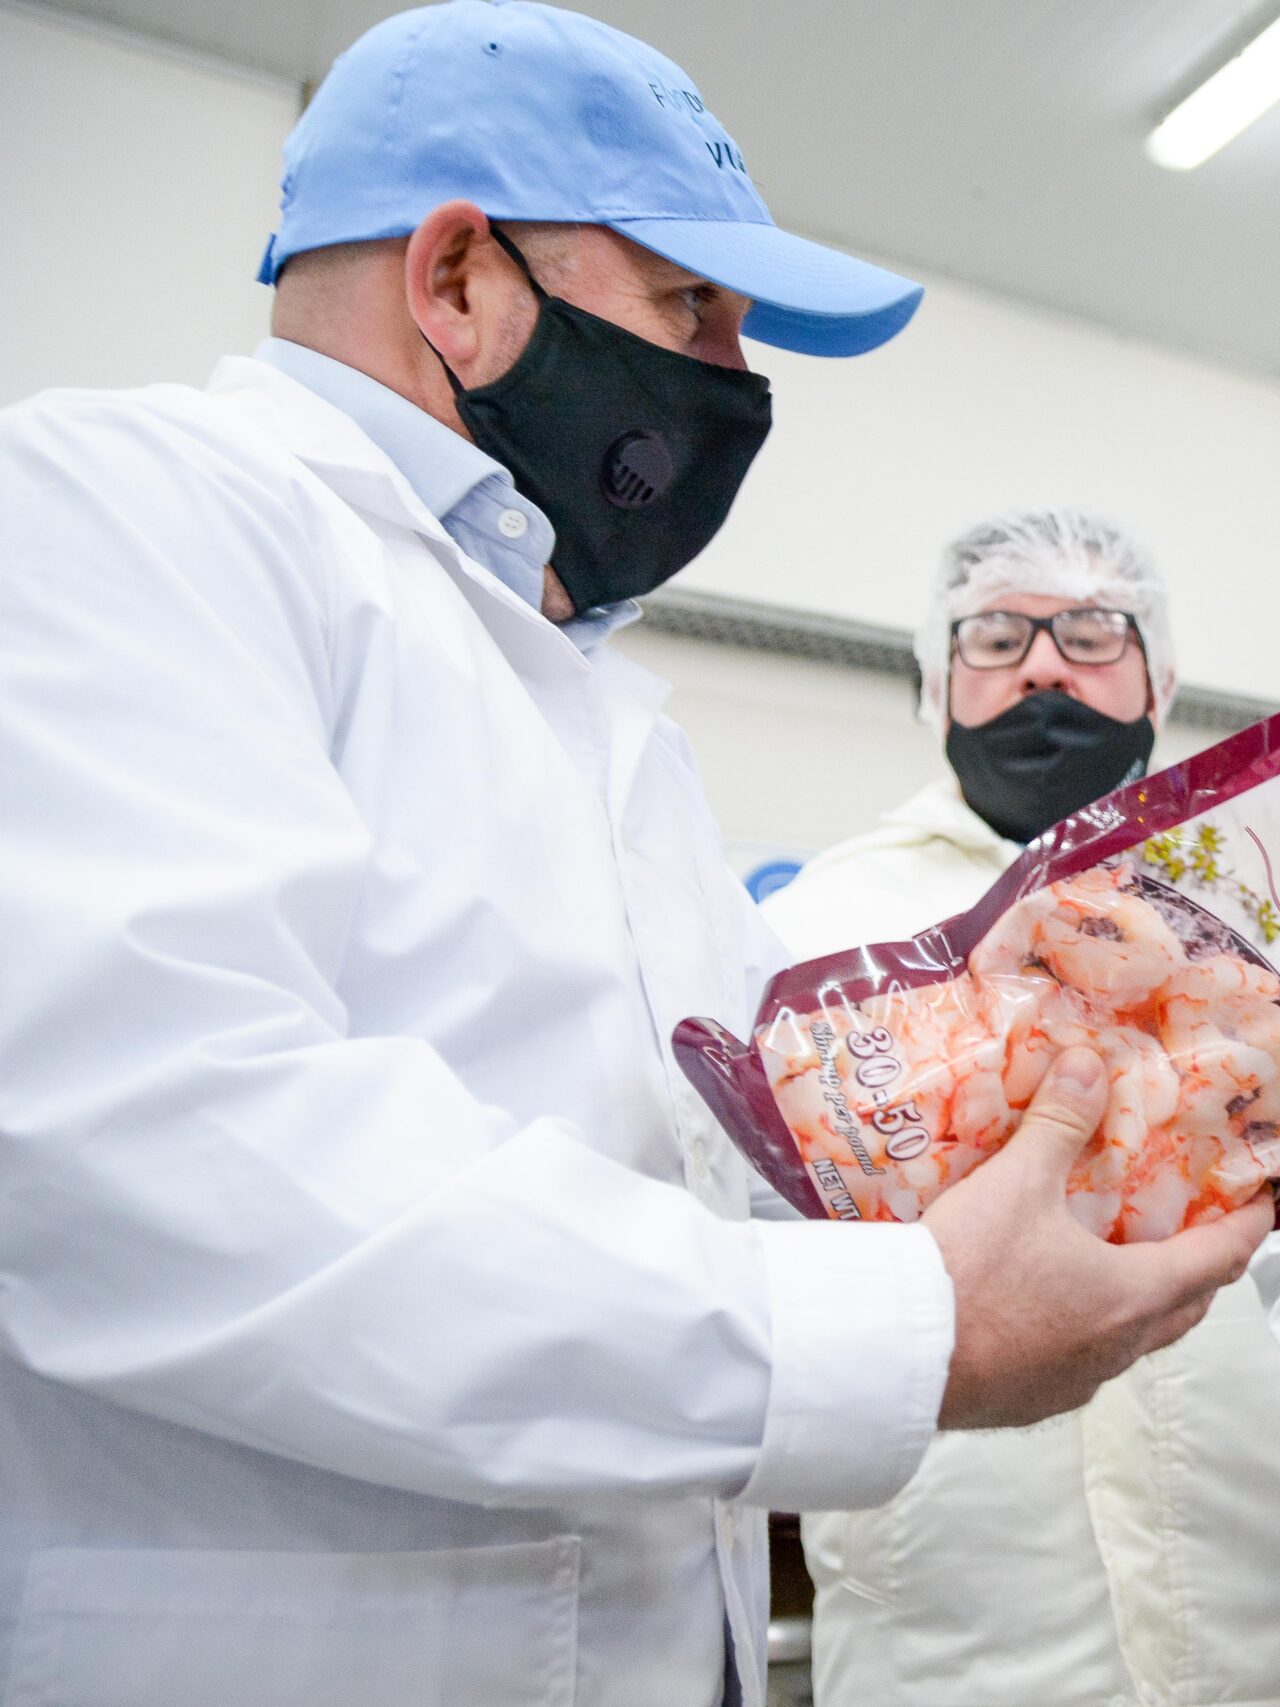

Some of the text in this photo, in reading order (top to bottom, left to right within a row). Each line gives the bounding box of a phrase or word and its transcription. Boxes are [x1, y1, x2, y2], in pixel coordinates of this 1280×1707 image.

[810, 1022, 886, 1177] Shrimp per pound
[846, 1026, 931, 1161] 30-50
[810, 1157, 847, 1192] NET
